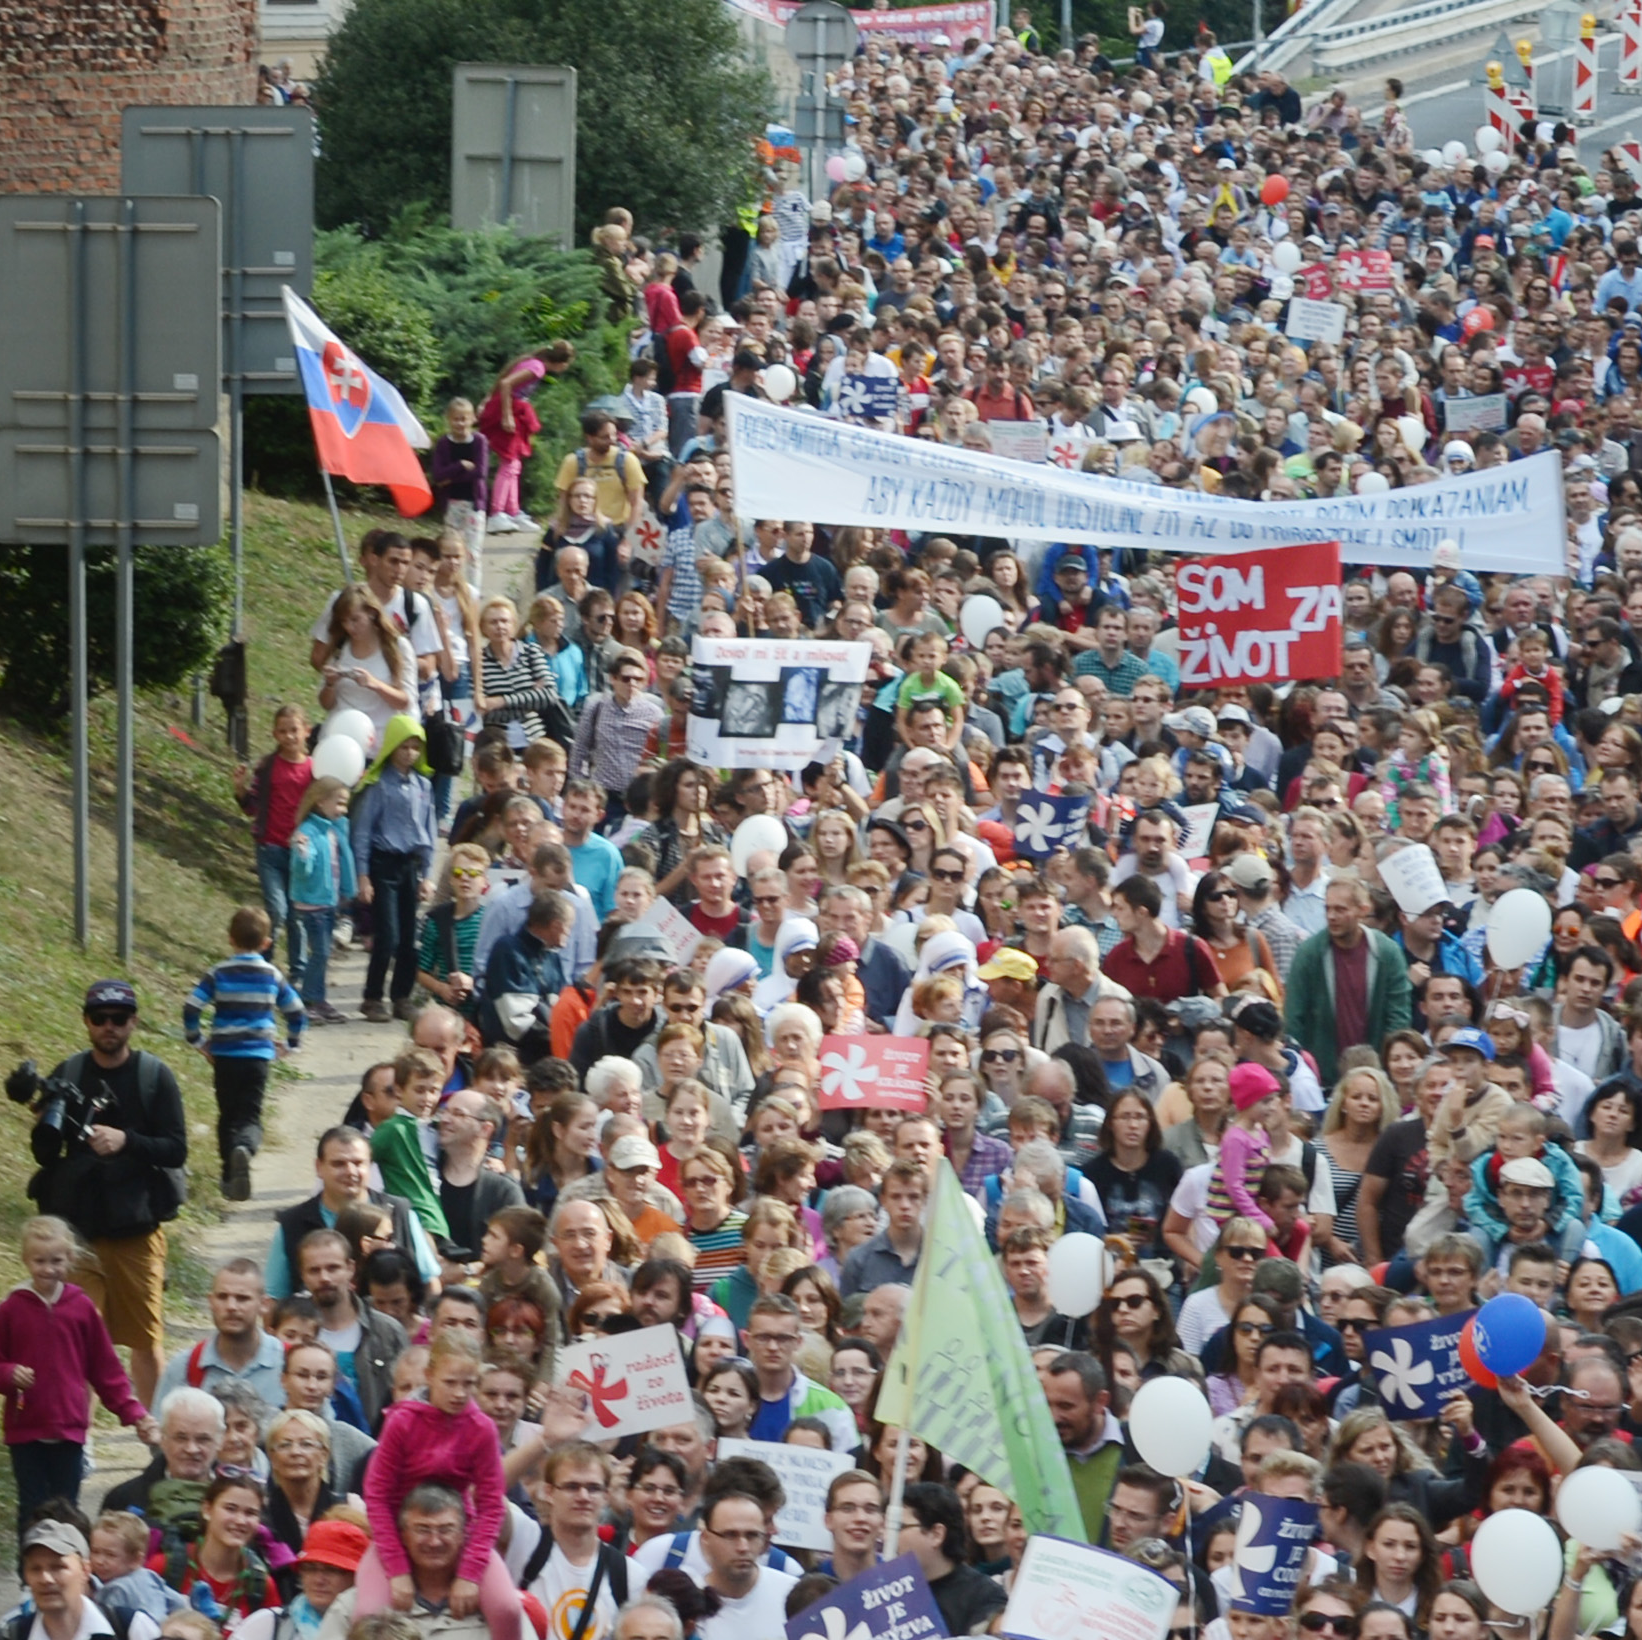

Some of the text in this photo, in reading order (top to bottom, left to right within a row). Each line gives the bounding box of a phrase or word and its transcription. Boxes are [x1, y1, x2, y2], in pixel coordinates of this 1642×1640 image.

[1176, 564, 1343, 632] SOM ZA
[861, 1575, 916, 1610] ŽIVOT
[885, 1601, 907, 1624] JE
